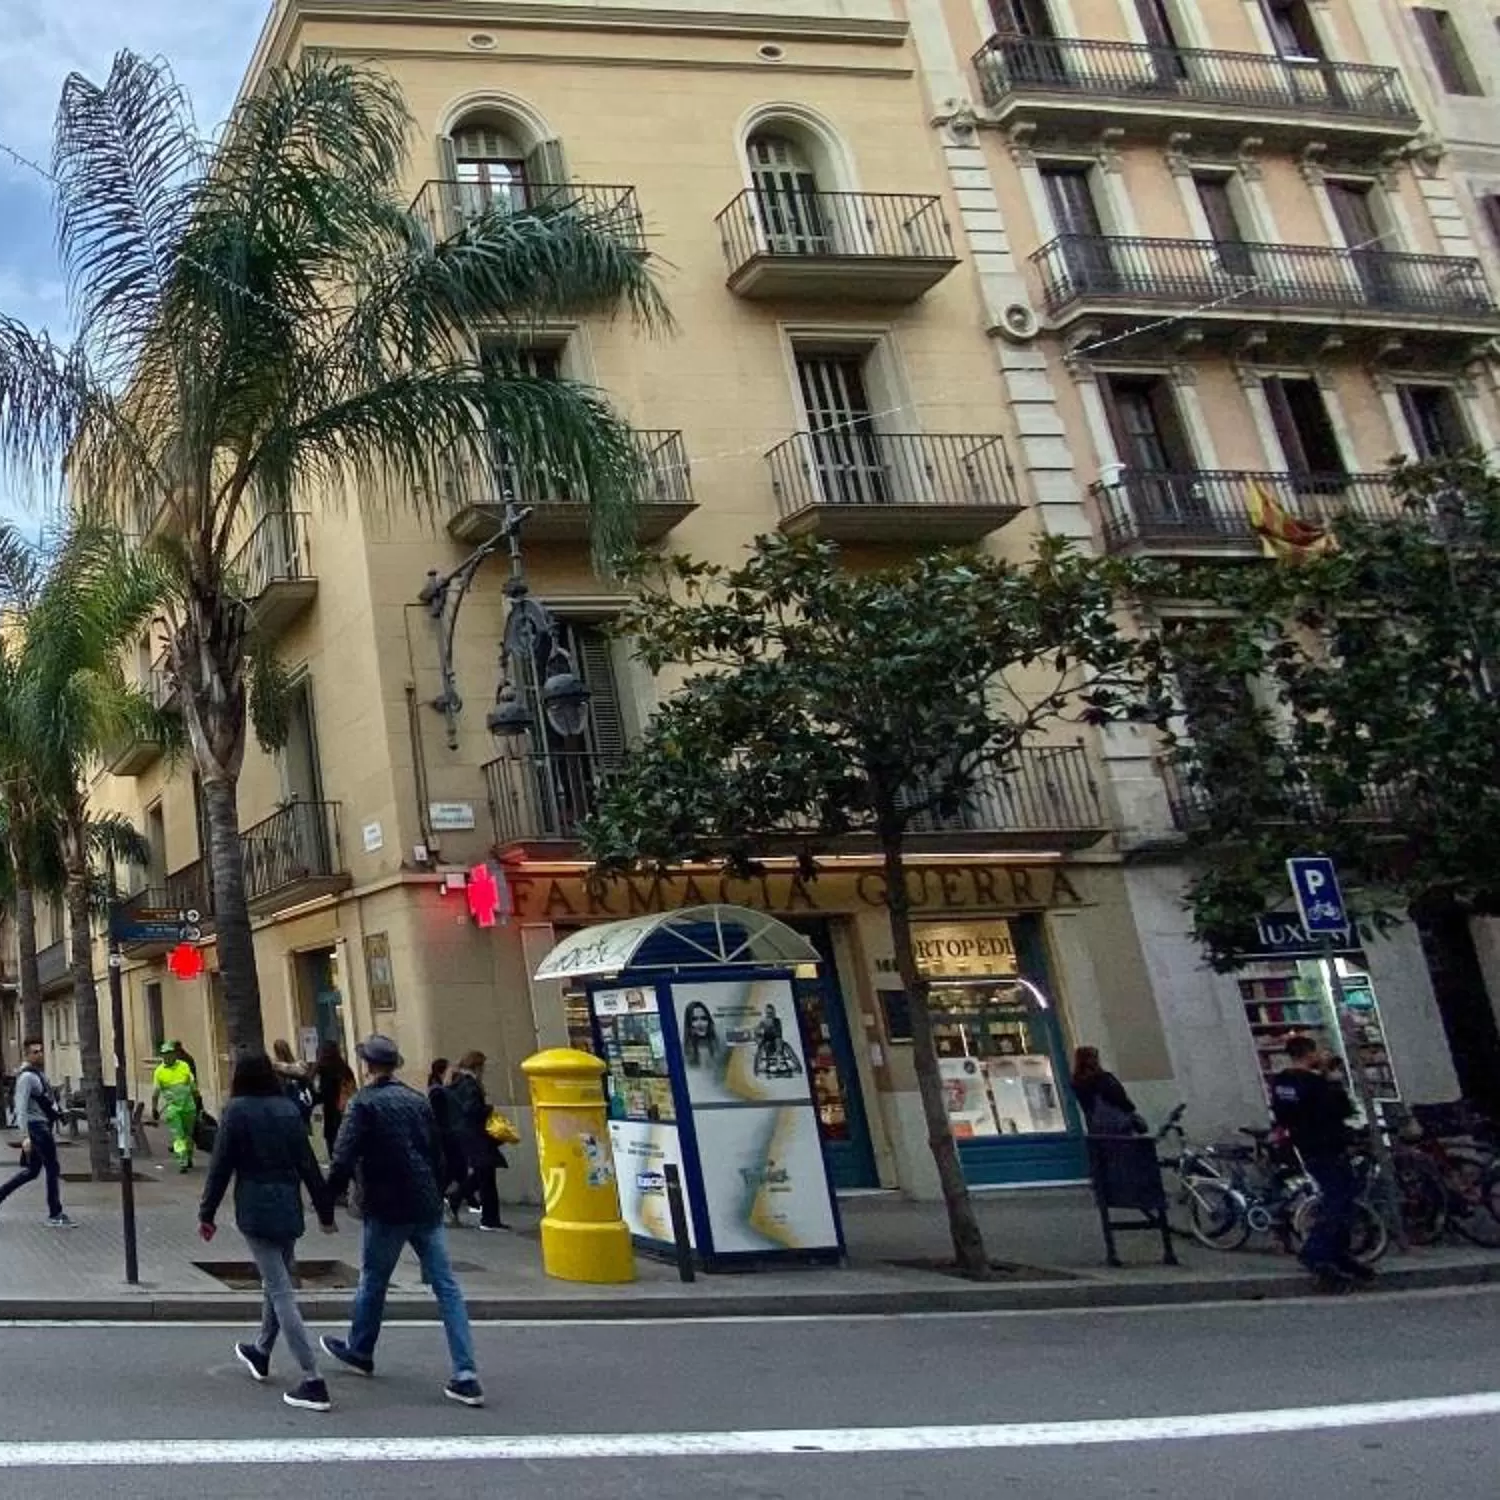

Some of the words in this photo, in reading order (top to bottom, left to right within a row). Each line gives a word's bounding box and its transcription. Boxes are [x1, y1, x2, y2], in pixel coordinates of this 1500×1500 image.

[509, 871, 820, 917] FARMACIA
[856, 866, 1082, 907] GUERRA
[1304, 868, 1326, 895] P
